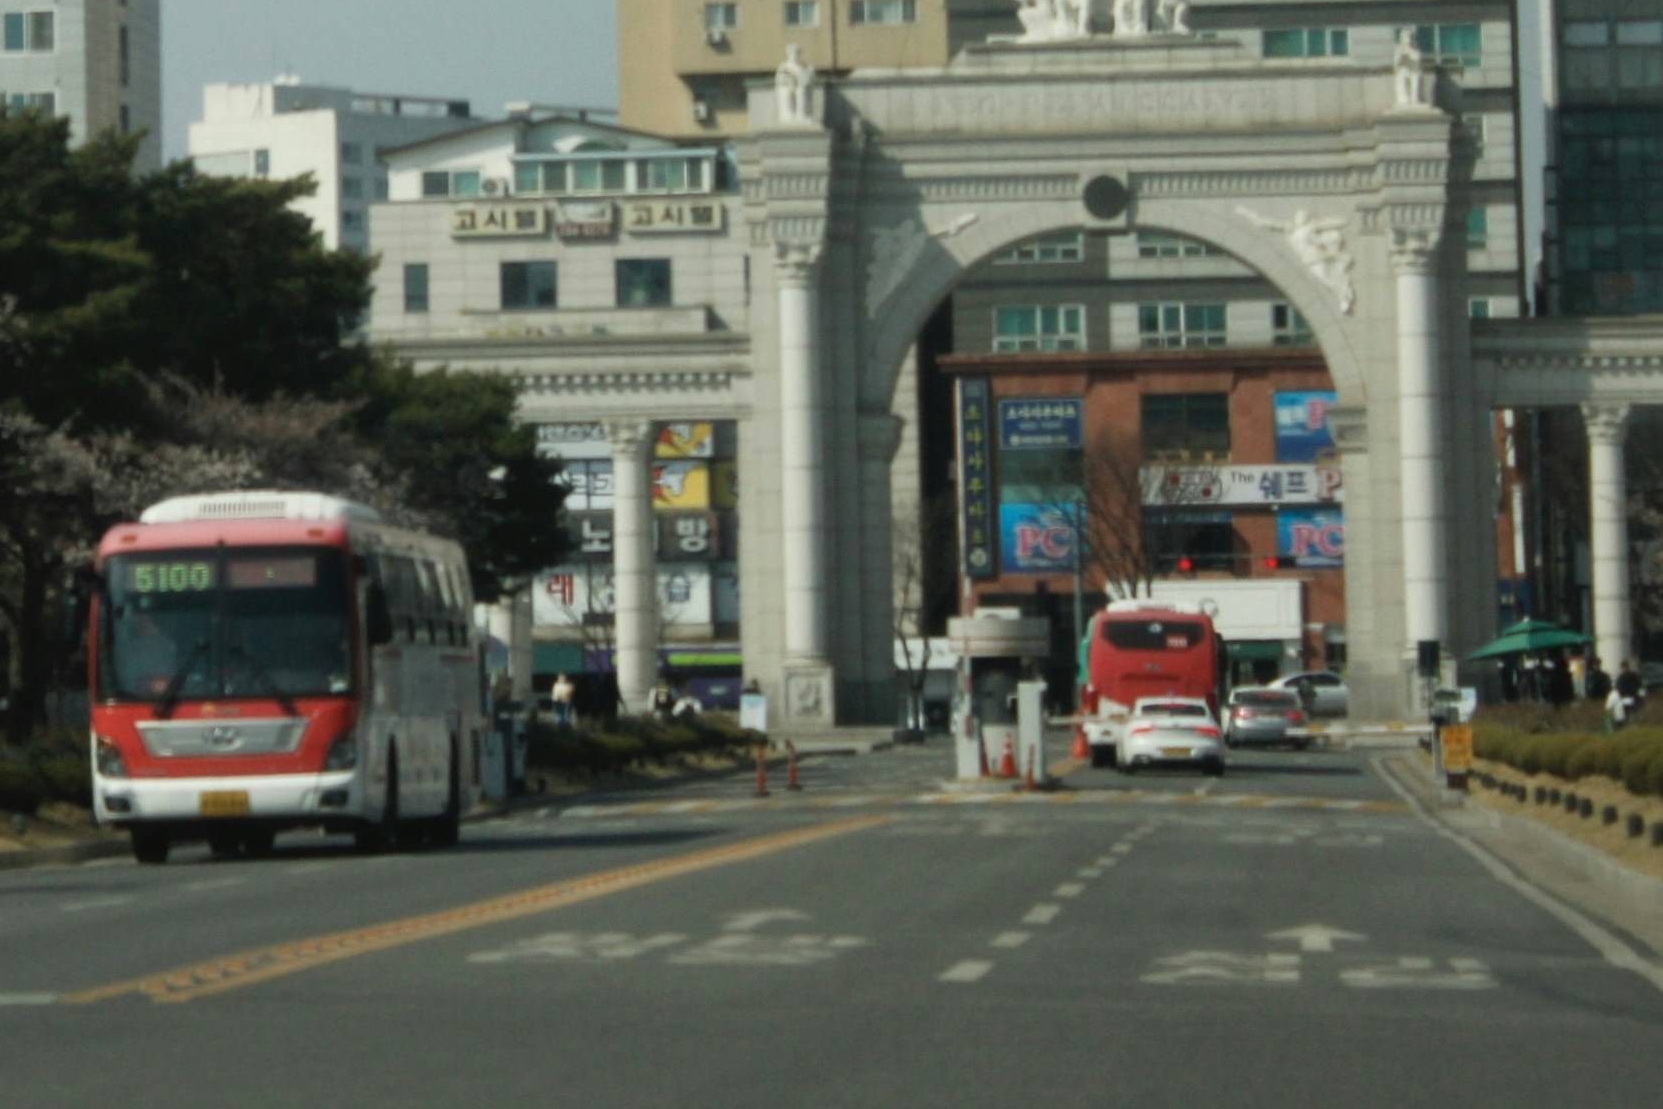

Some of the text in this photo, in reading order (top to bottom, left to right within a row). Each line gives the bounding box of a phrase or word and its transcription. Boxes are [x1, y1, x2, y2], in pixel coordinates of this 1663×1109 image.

[1230, 471, 1255, 484] The
[581, 517, 708, 553] 노방
[1016, 525, 1070, 559] PC
[1291, 523, 1343, 556] PC
[134, 563, 210, 592] 5100
